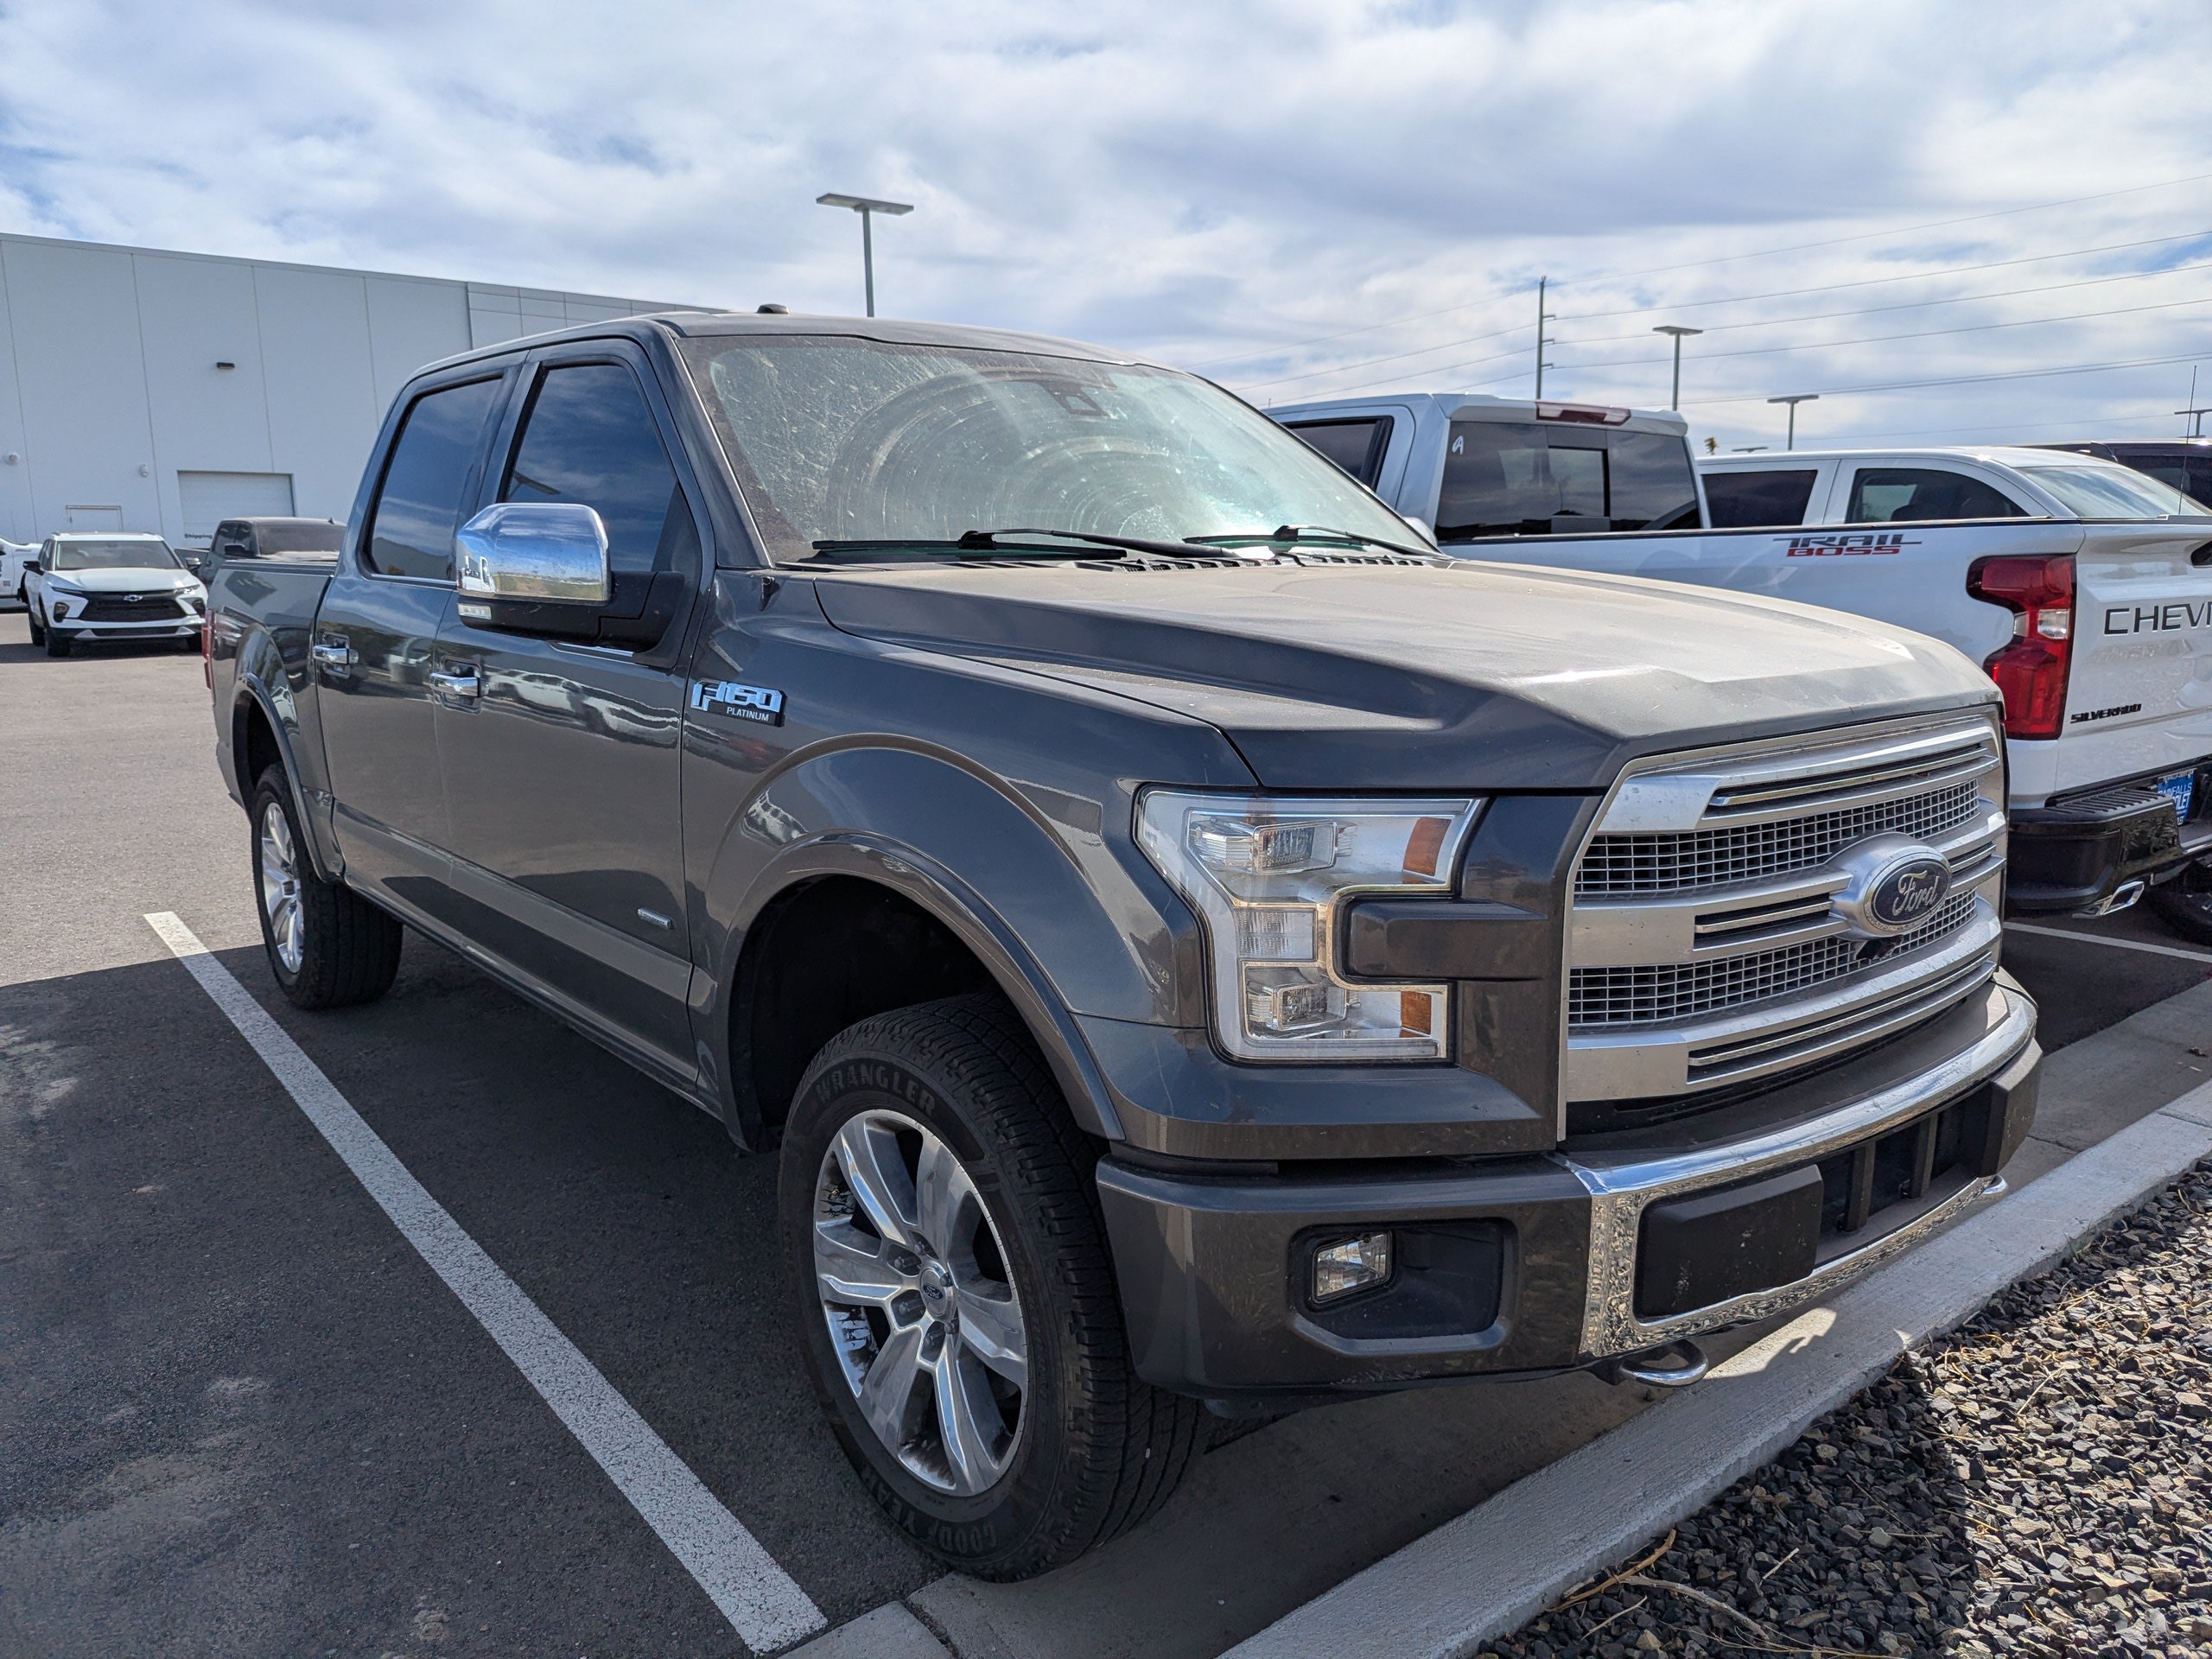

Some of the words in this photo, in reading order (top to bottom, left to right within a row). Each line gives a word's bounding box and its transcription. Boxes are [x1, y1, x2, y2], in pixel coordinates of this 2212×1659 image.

[1773, 534, 1923, 548] TRAIL
[1786, 545, 1901, 557] BOSS
[726, 706, 771, 722] PLATINUM
[2069, 703, 2143, 724] SILVERADO
[1891, 870, 1940, 917] Ford
[815, 1063, 936, 1117] WRANGLER
[925, 1286, 940, 1300] Ford
